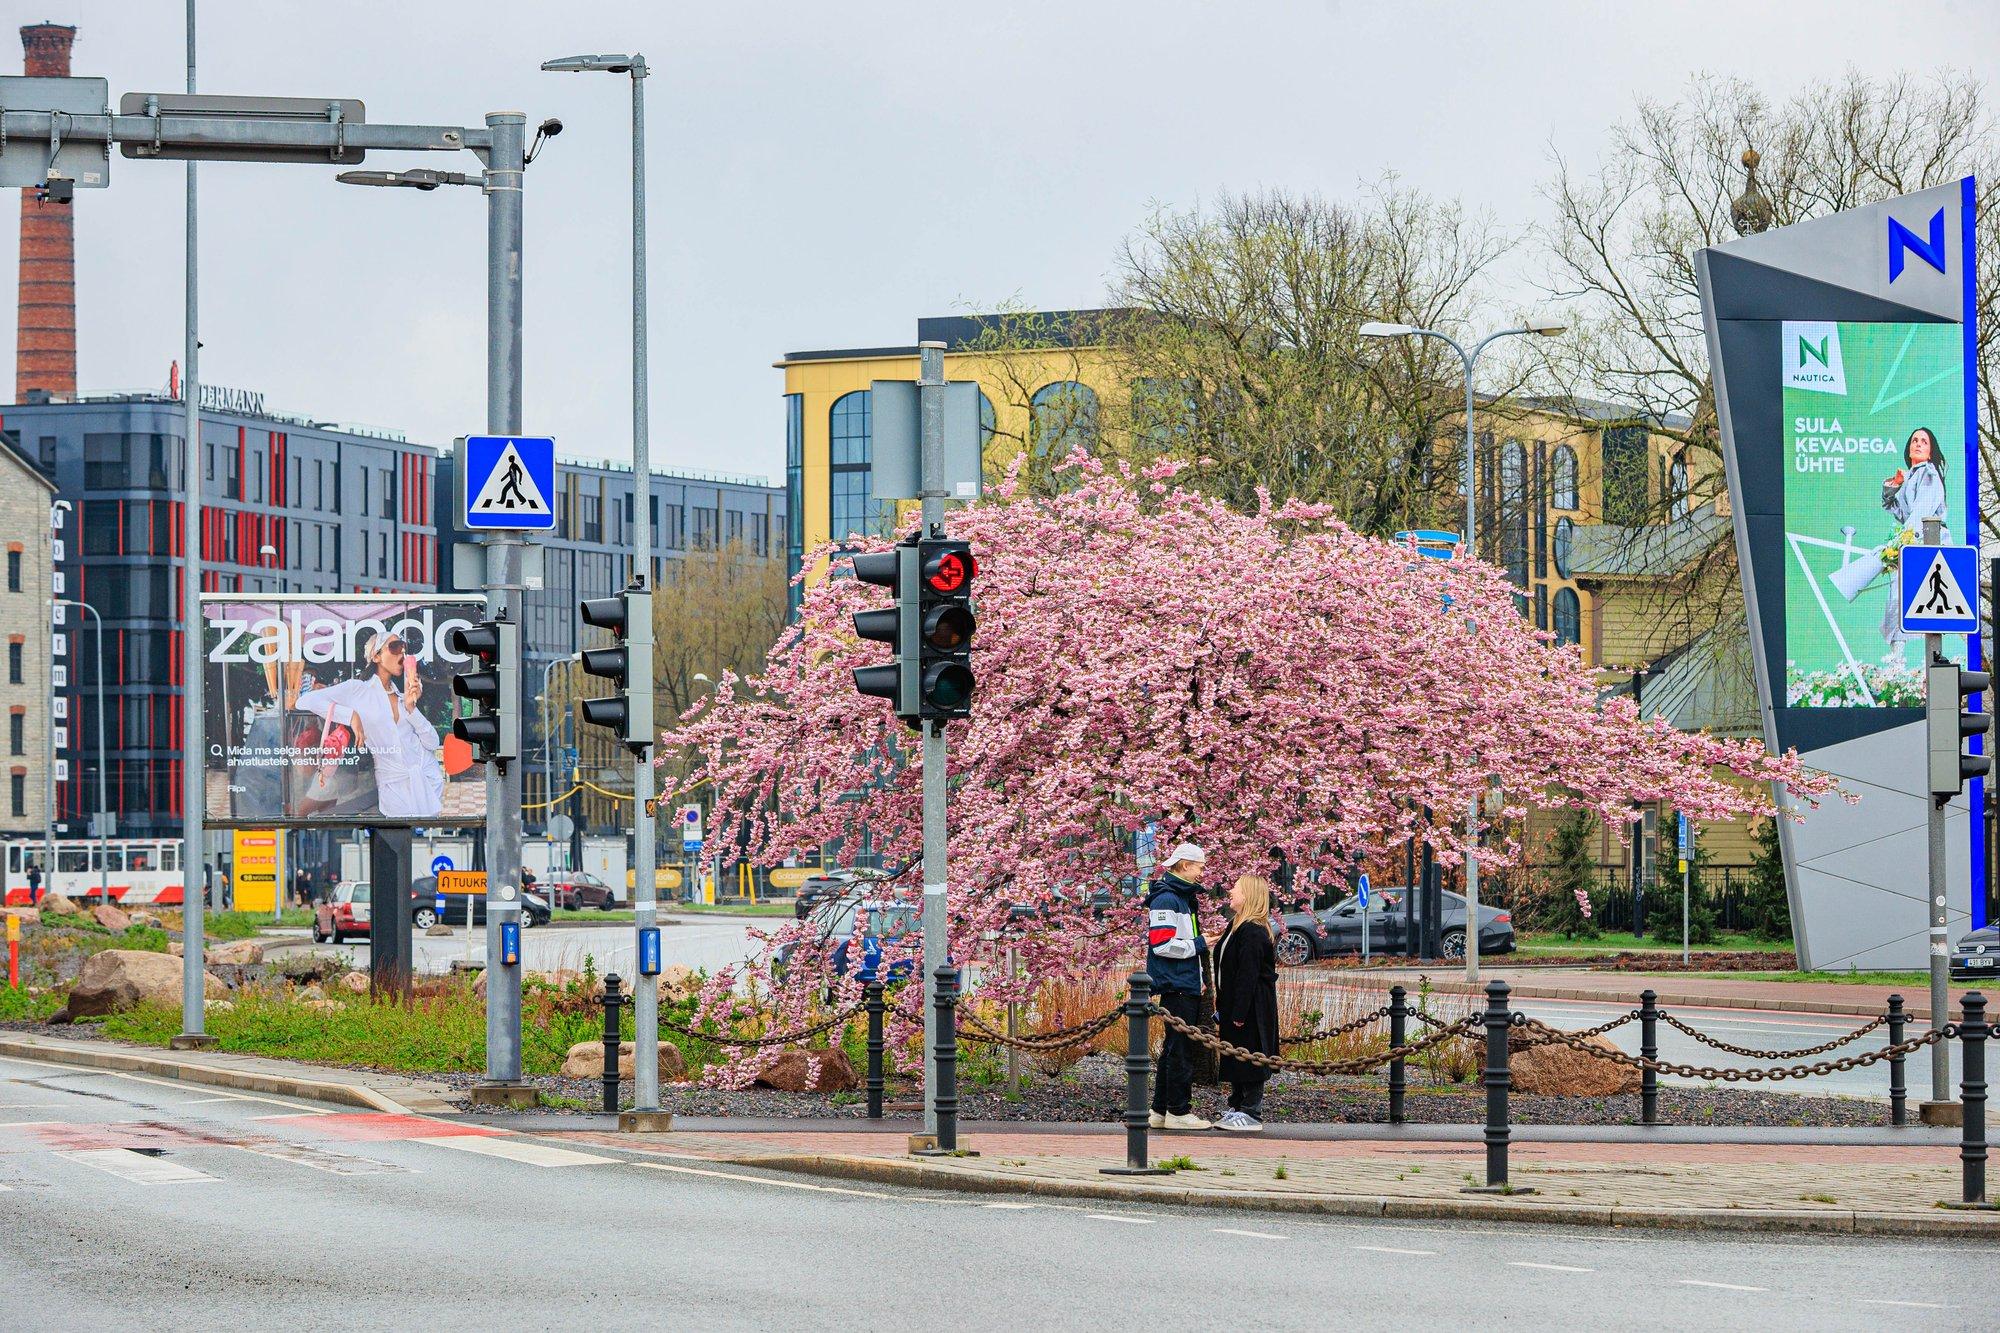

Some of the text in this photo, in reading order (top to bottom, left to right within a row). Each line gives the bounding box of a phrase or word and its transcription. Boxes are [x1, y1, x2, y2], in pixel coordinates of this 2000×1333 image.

[1793, 374, 1836, 383] NAUTICA
[1794, 416, 1843, 434] SULA
[1795, 437, 1898, 454] KEVADEGA
[1795, 453, 1845, 473] ÜHTE
[208, 609, 474, 663] zalando
[227, 744, 402, 758] Mida ma selga panen, kui ei suuda
[227, 755, 360, 768] ahvatlustele vastu panna?
[452, 877, 487, 888] TUUKR
